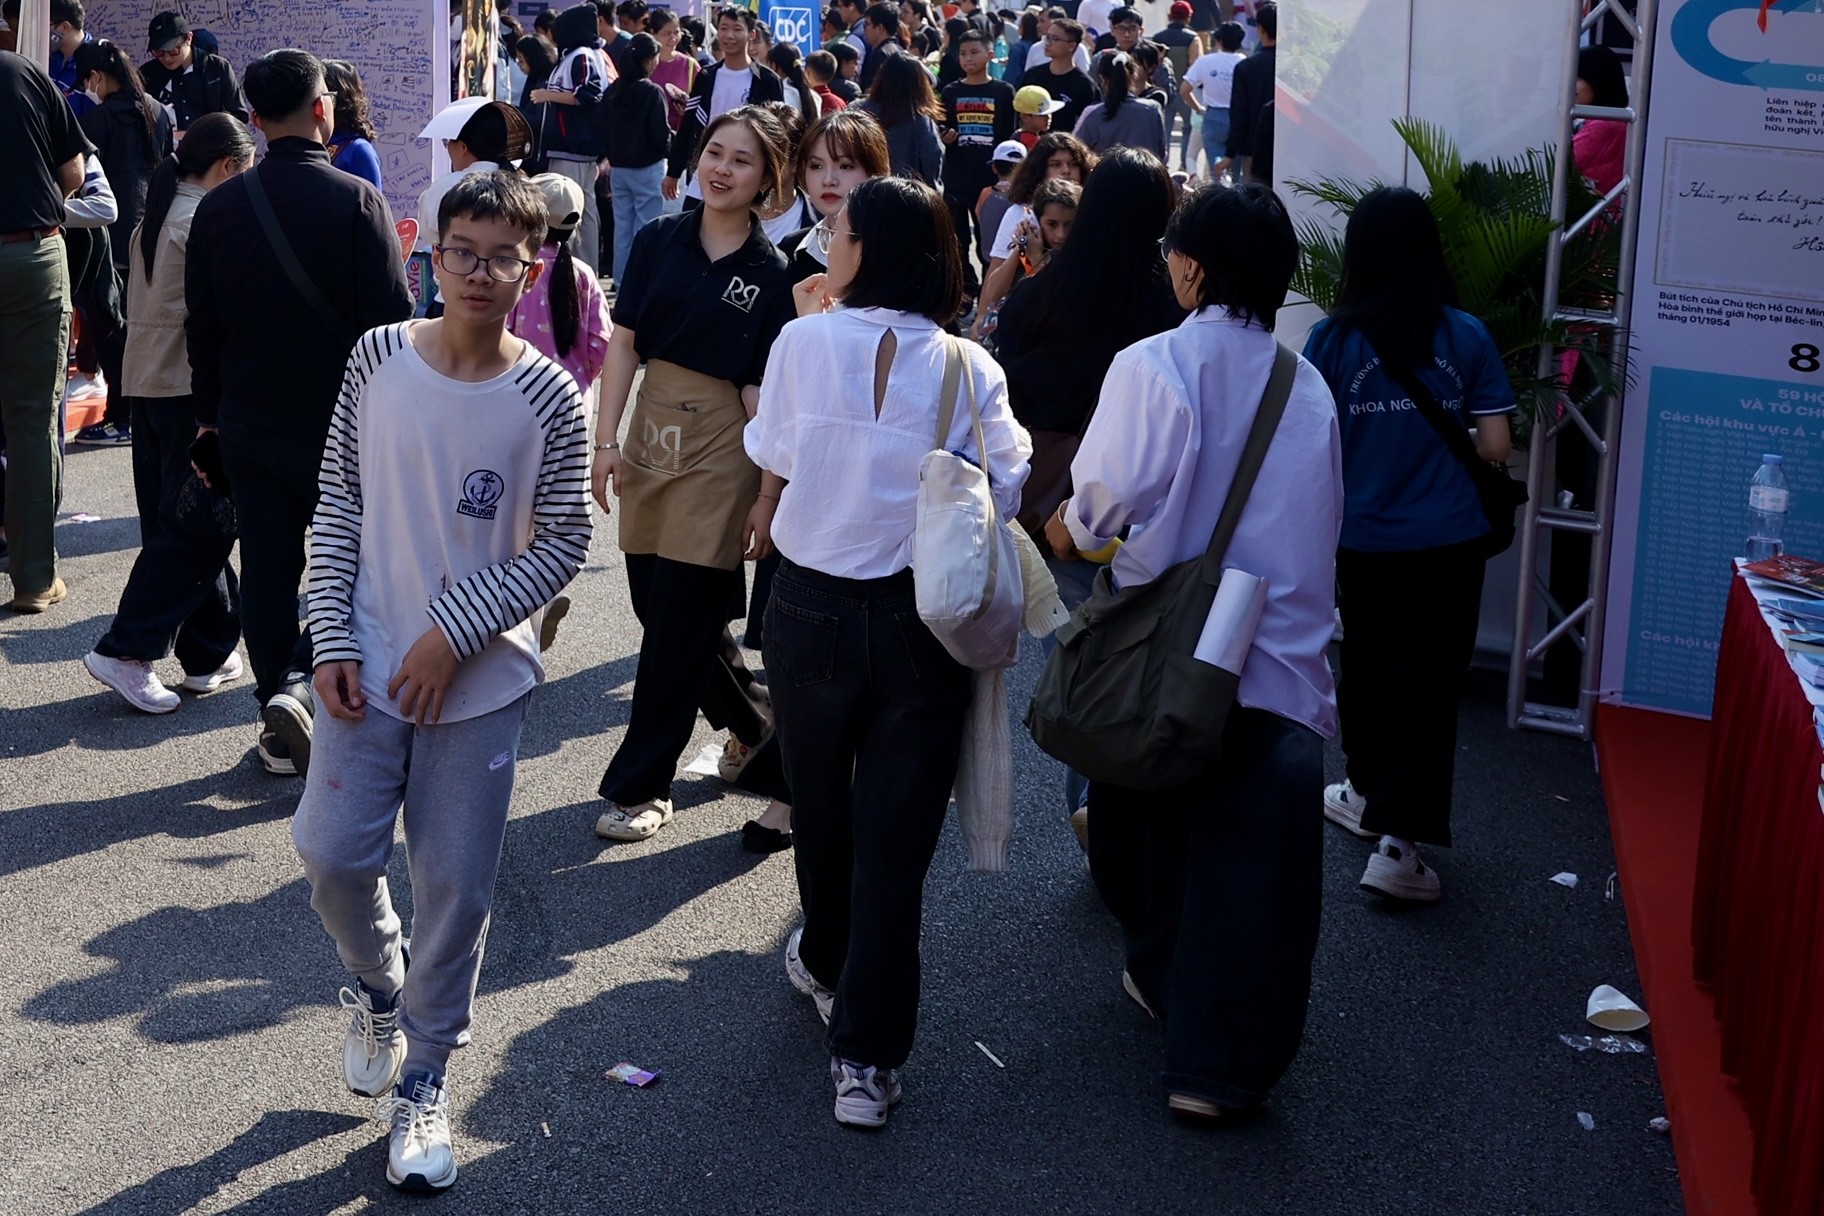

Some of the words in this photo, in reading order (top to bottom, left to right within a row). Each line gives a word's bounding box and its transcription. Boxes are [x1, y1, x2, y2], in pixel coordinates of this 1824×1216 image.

[775, 18, 807, 43] CDC
[407, 261, 420, 302] aVie
[1660, 292, 1677, 301] Bút
[1680, 292, 1698, 304] tích
[1701, 296, 1720, 305] của
[1722, 298, 1743, 308] Chủ
[1746, 301, 1765, 310] tịch
[1768, 303, 1782, 312] Hồ
[1785, 305, 1803, 315] Chí
[1658, 312, 1687, 324] tháng
[1690, 315, 1730, 327] 01/1954
[1789, 343, 1820, 372] 8
[1779, 389, 1800, 400] 59
[1349, 401, 1386, 415] KHOA
[1740, 398, 1763, 410] VÀ
[1768, 401, 1792, 414] TỔ
[1660, 410, 1691, 423] Các
[1695, 415, 1720, 428] hội
[1724, 419, 1754, 431] khu
[1758, 423, 1789, 436] vực
[1794, 425, 1805, 437] Á
[461, 503, 494, 517] WEILUSHI
